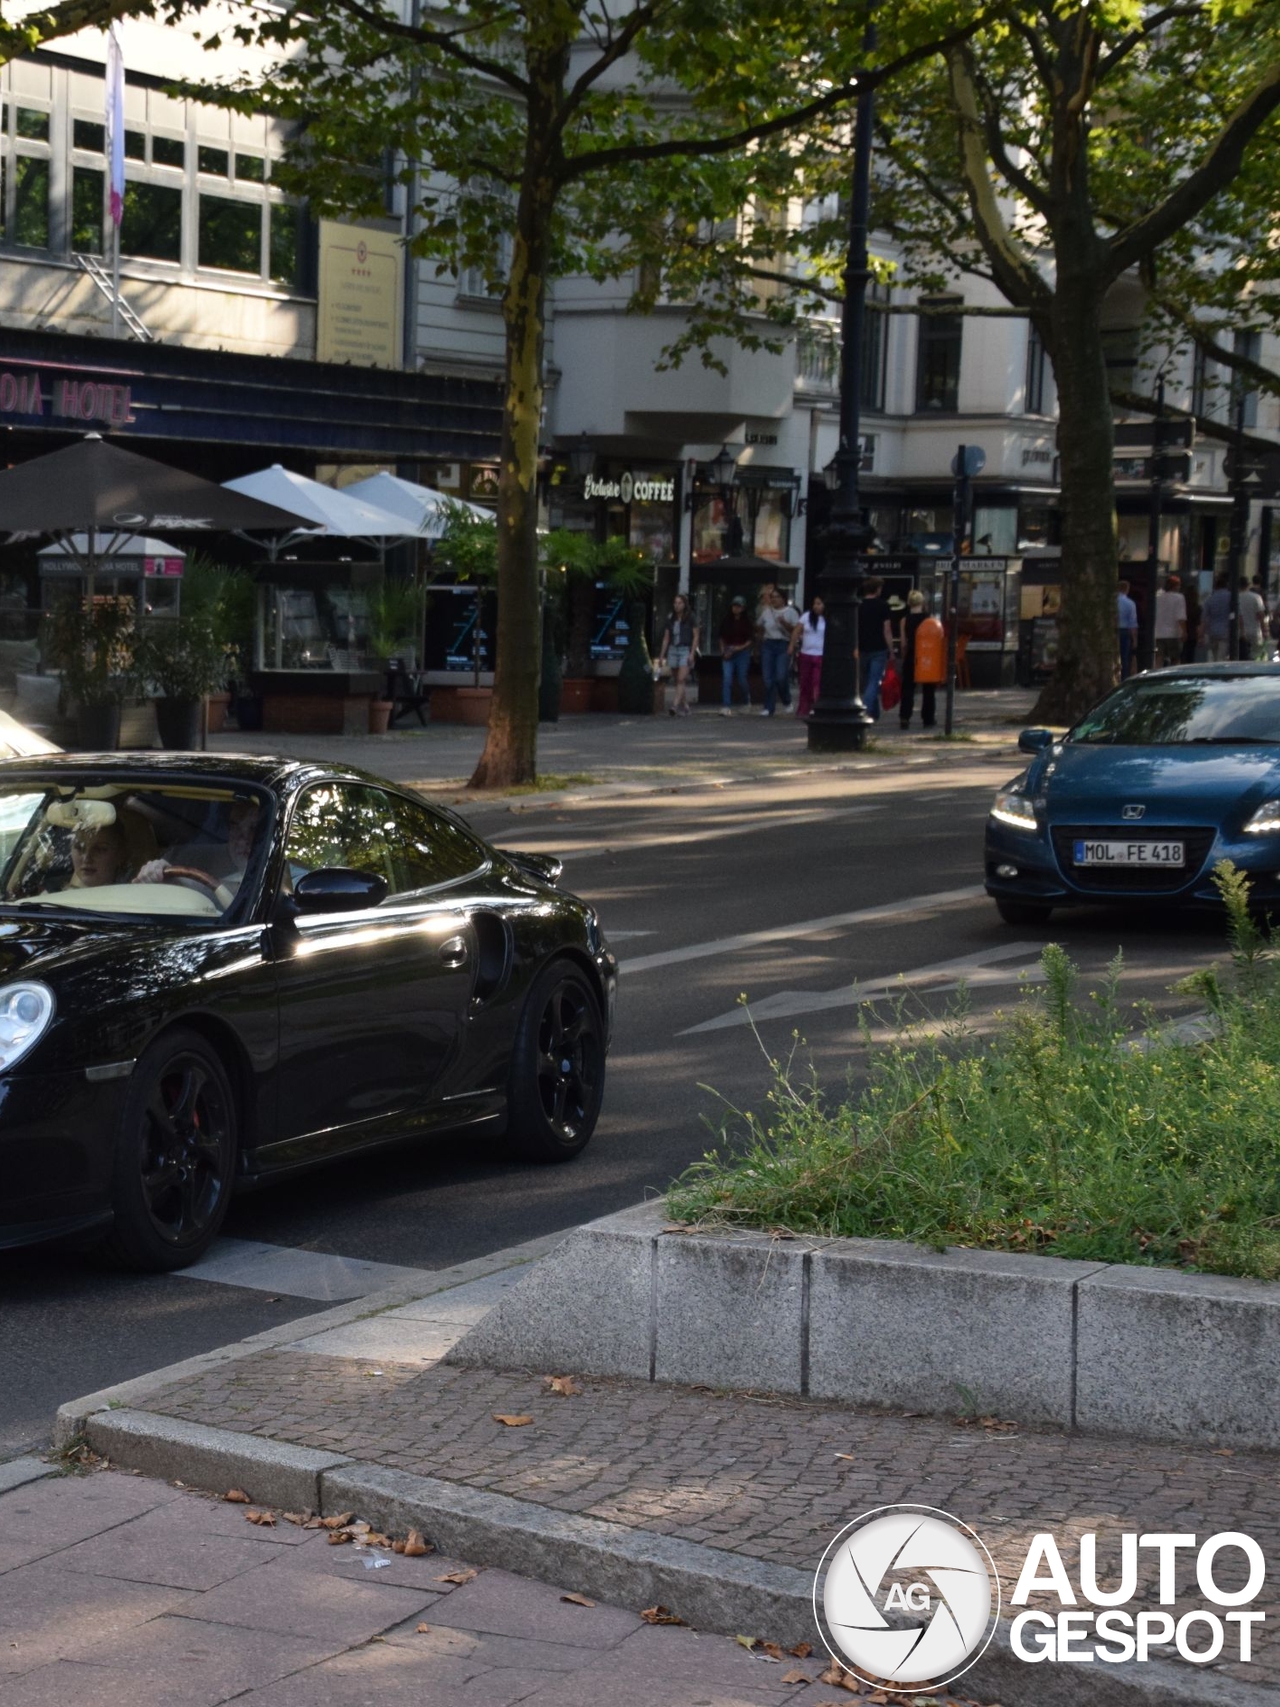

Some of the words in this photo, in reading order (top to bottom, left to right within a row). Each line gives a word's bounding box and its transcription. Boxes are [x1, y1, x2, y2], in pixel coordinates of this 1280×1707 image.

[62, 379, 136, 424] HOTEL
[634, 478, 675, 502] COFFEE
[118, 562, 140, 573] HOTEL
[1085, 844, 1115, 861] MOL
[1127, 844, 1147, 861] FE
[1152, 845, 1181, 862] 418
